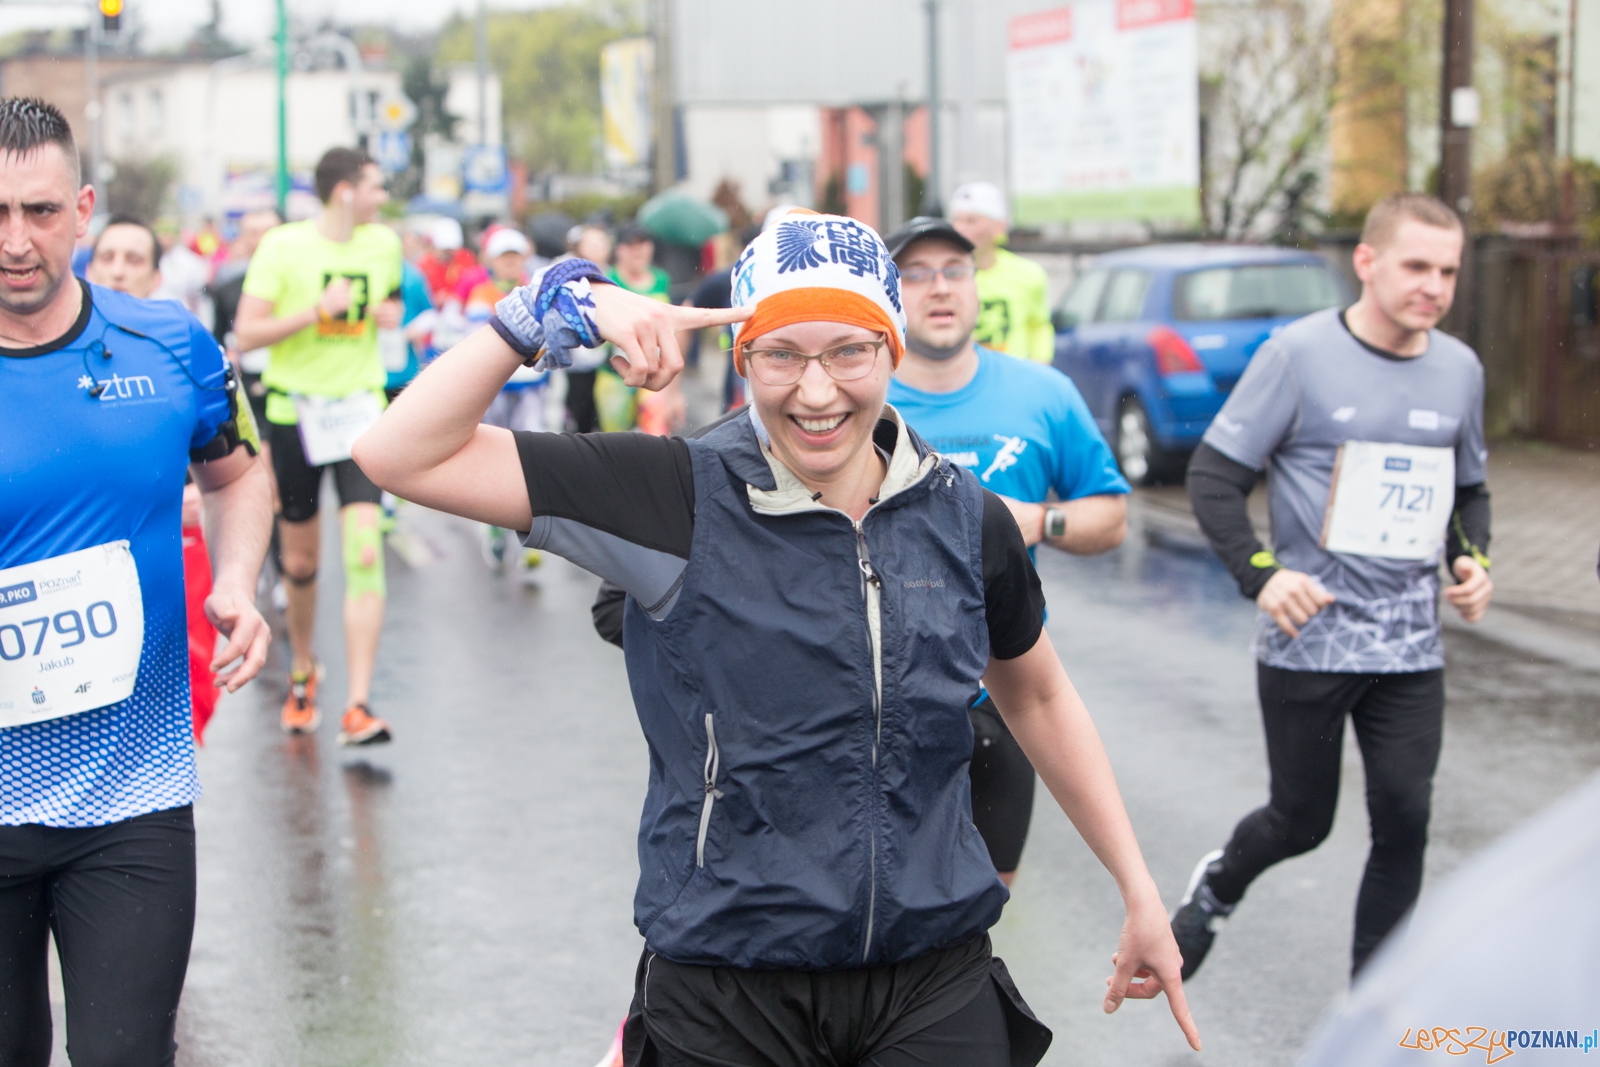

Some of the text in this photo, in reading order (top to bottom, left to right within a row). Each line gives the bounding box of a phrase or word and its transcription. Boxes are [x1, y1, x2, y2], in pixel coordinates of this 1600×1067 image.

[97, 372, 156, 401] ztm
[1380, 482, 1433, 513] 7121
[0, 600, 118, 661] 0790
[38, 656, 75, 673] Jakub
